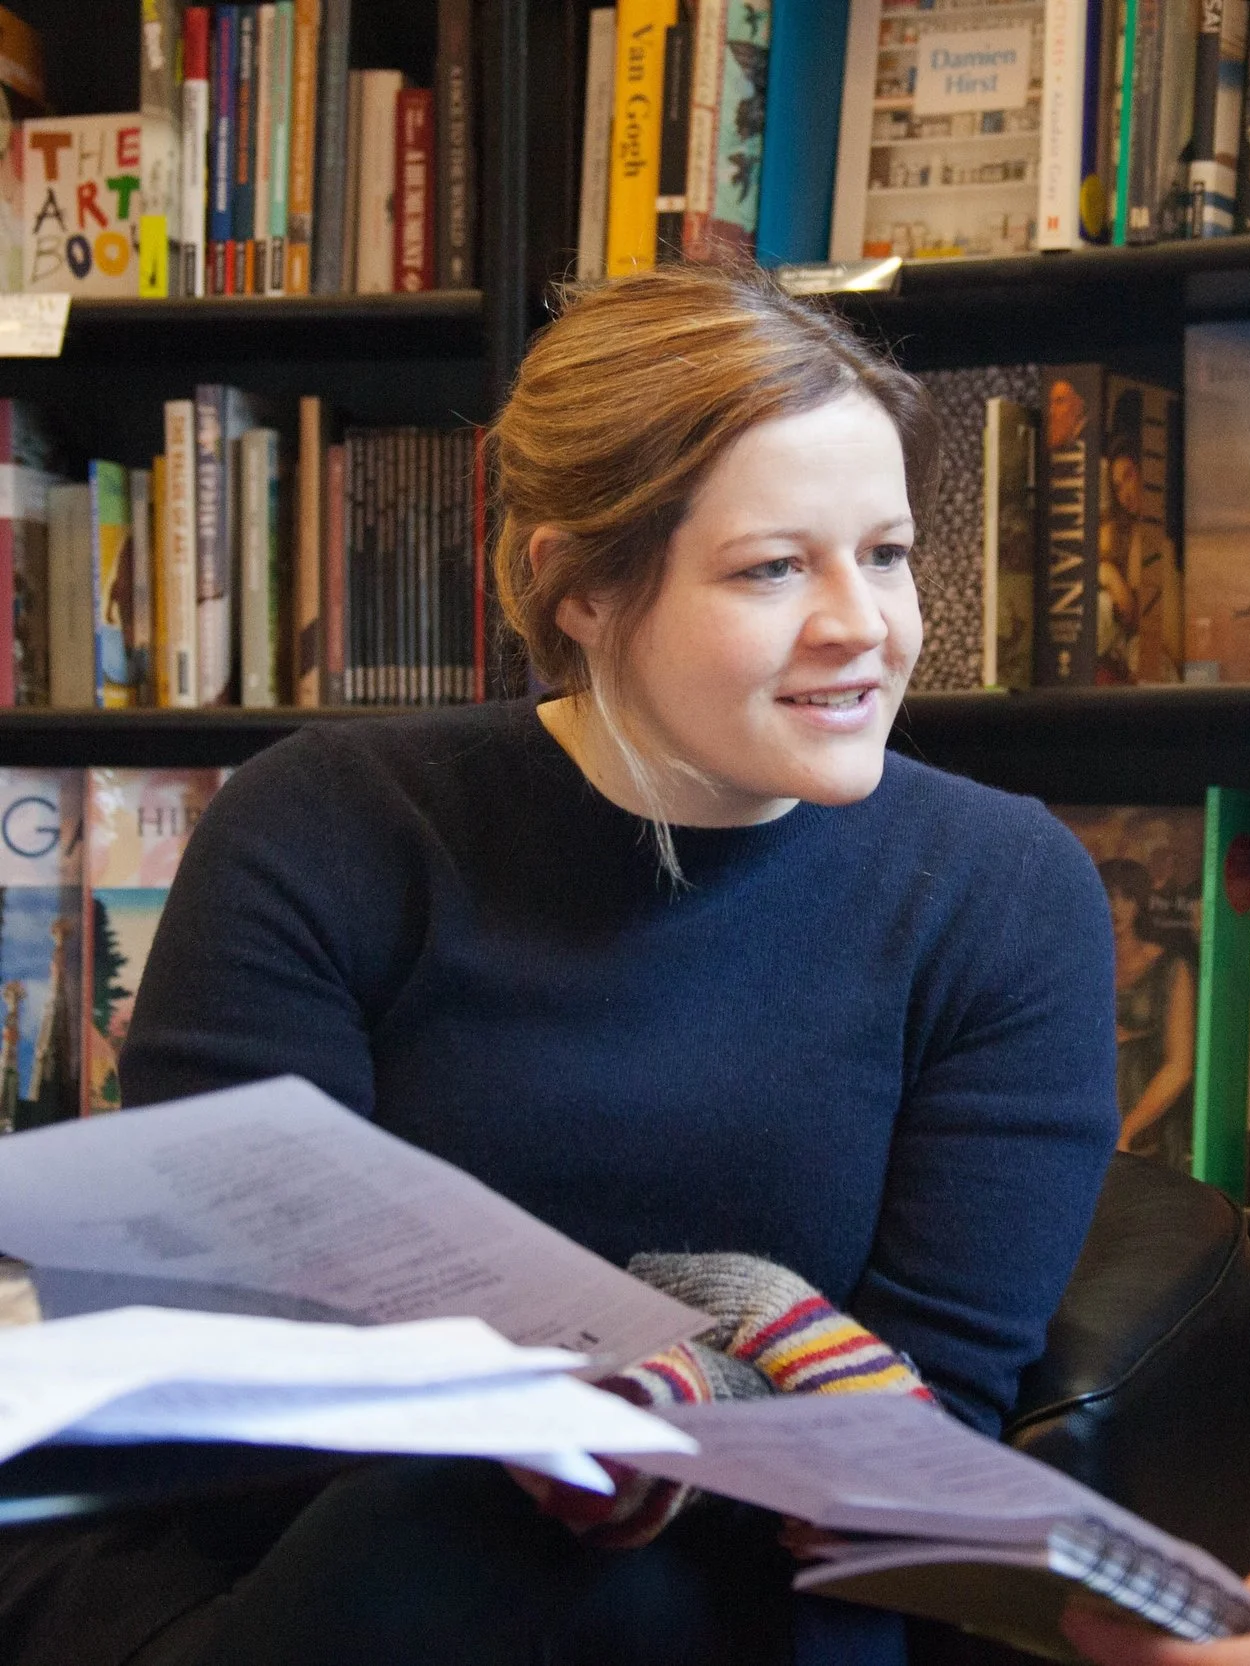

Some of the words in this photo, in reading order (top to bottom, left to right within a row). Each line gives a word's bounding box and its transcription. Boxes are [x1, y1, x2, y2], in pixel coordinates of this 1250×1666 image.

[628, 23, 652, 82] Van
[930, 45, 1018, 71] Damien
[945, 72, 998, 96] Hirst
[30, 126, 141, 183] THE
[620, 93, 652, 178] Gogh
[34, 175, 141, 236] ART
[1050, 441, 1086, 615] TITIAN
